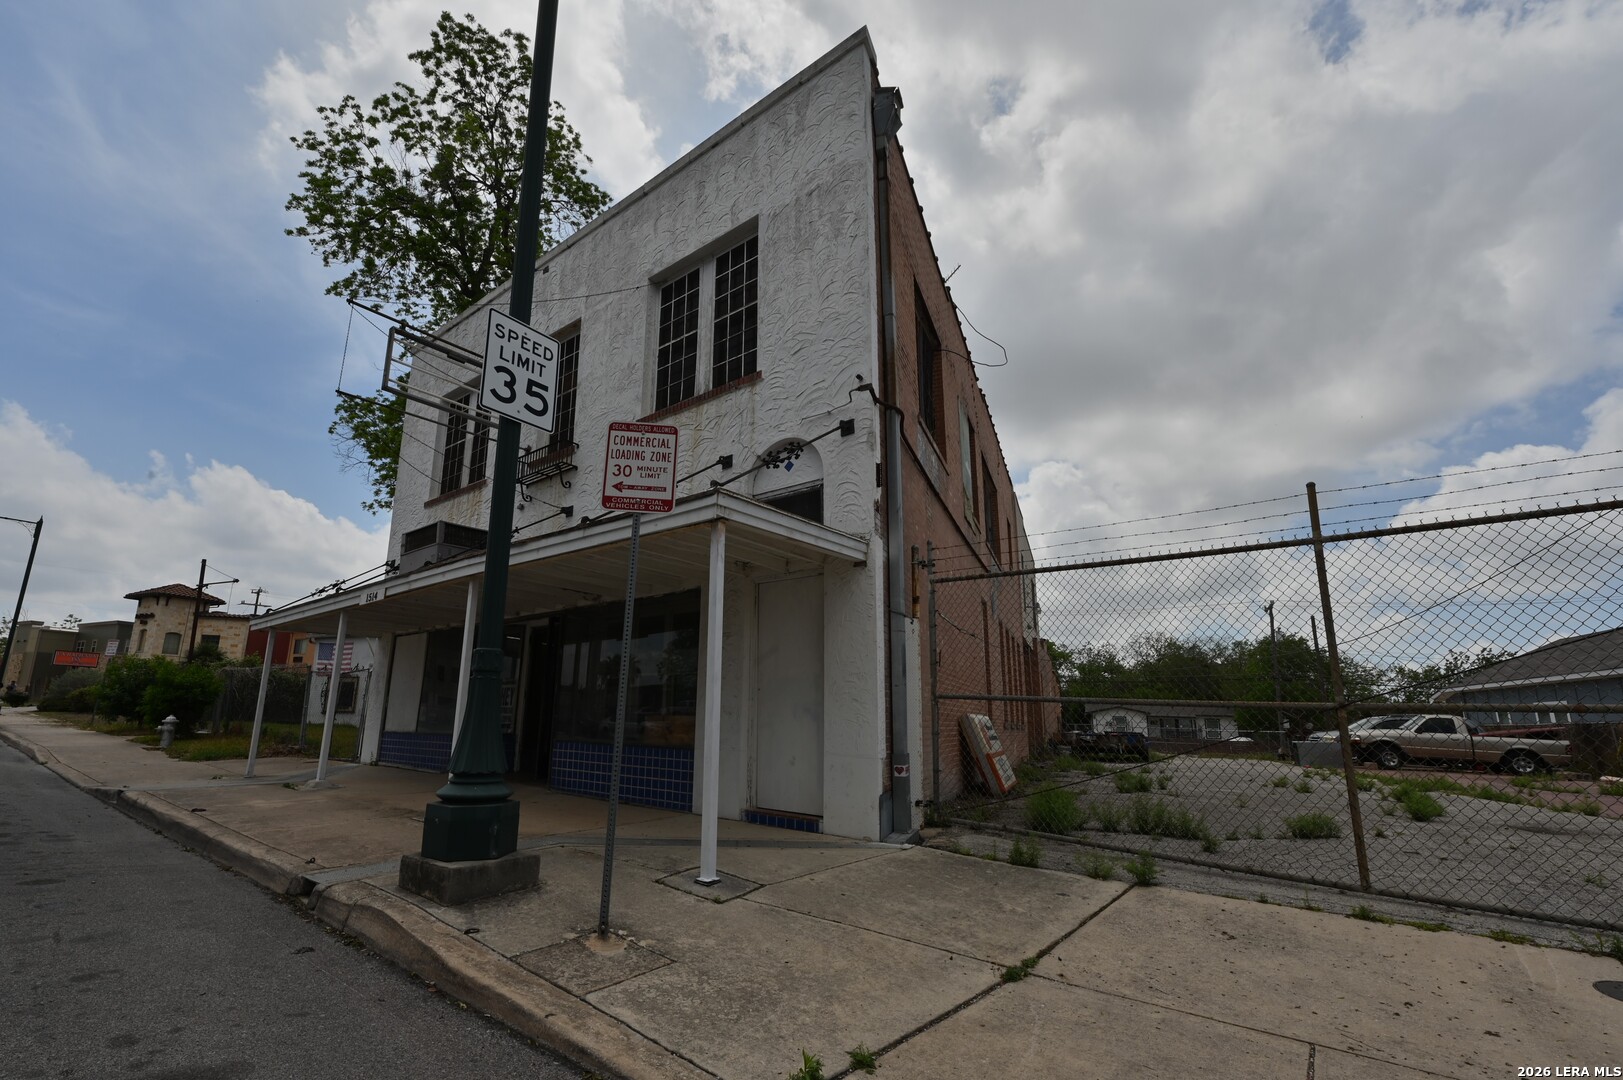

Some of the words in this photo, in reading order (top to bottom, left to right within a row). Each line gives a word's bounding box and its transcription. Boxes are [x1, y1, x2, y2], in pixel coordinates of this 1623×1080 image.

[494, 323, 554, 361] SPEED
[499, 345, 546, 377] LIMIT
[489, 365, 549, 417] 35
[612, 423, 628, 431] DECAL
[629, 424, 652, 432] HOLDERS
[652, 425, 675, 434] ALLOWED
[613, 435, 671, 449] COMMERCIAL
[610, 449, 646, 461] LOADING
[649, 451, 672, 463] ZONE
[612, 464, 632, 477] 30
[636, 465, 668, 473] MINUTE
[605, 502, 645, 510] VEHICLES
[365, 591, 379, 602] 1514
